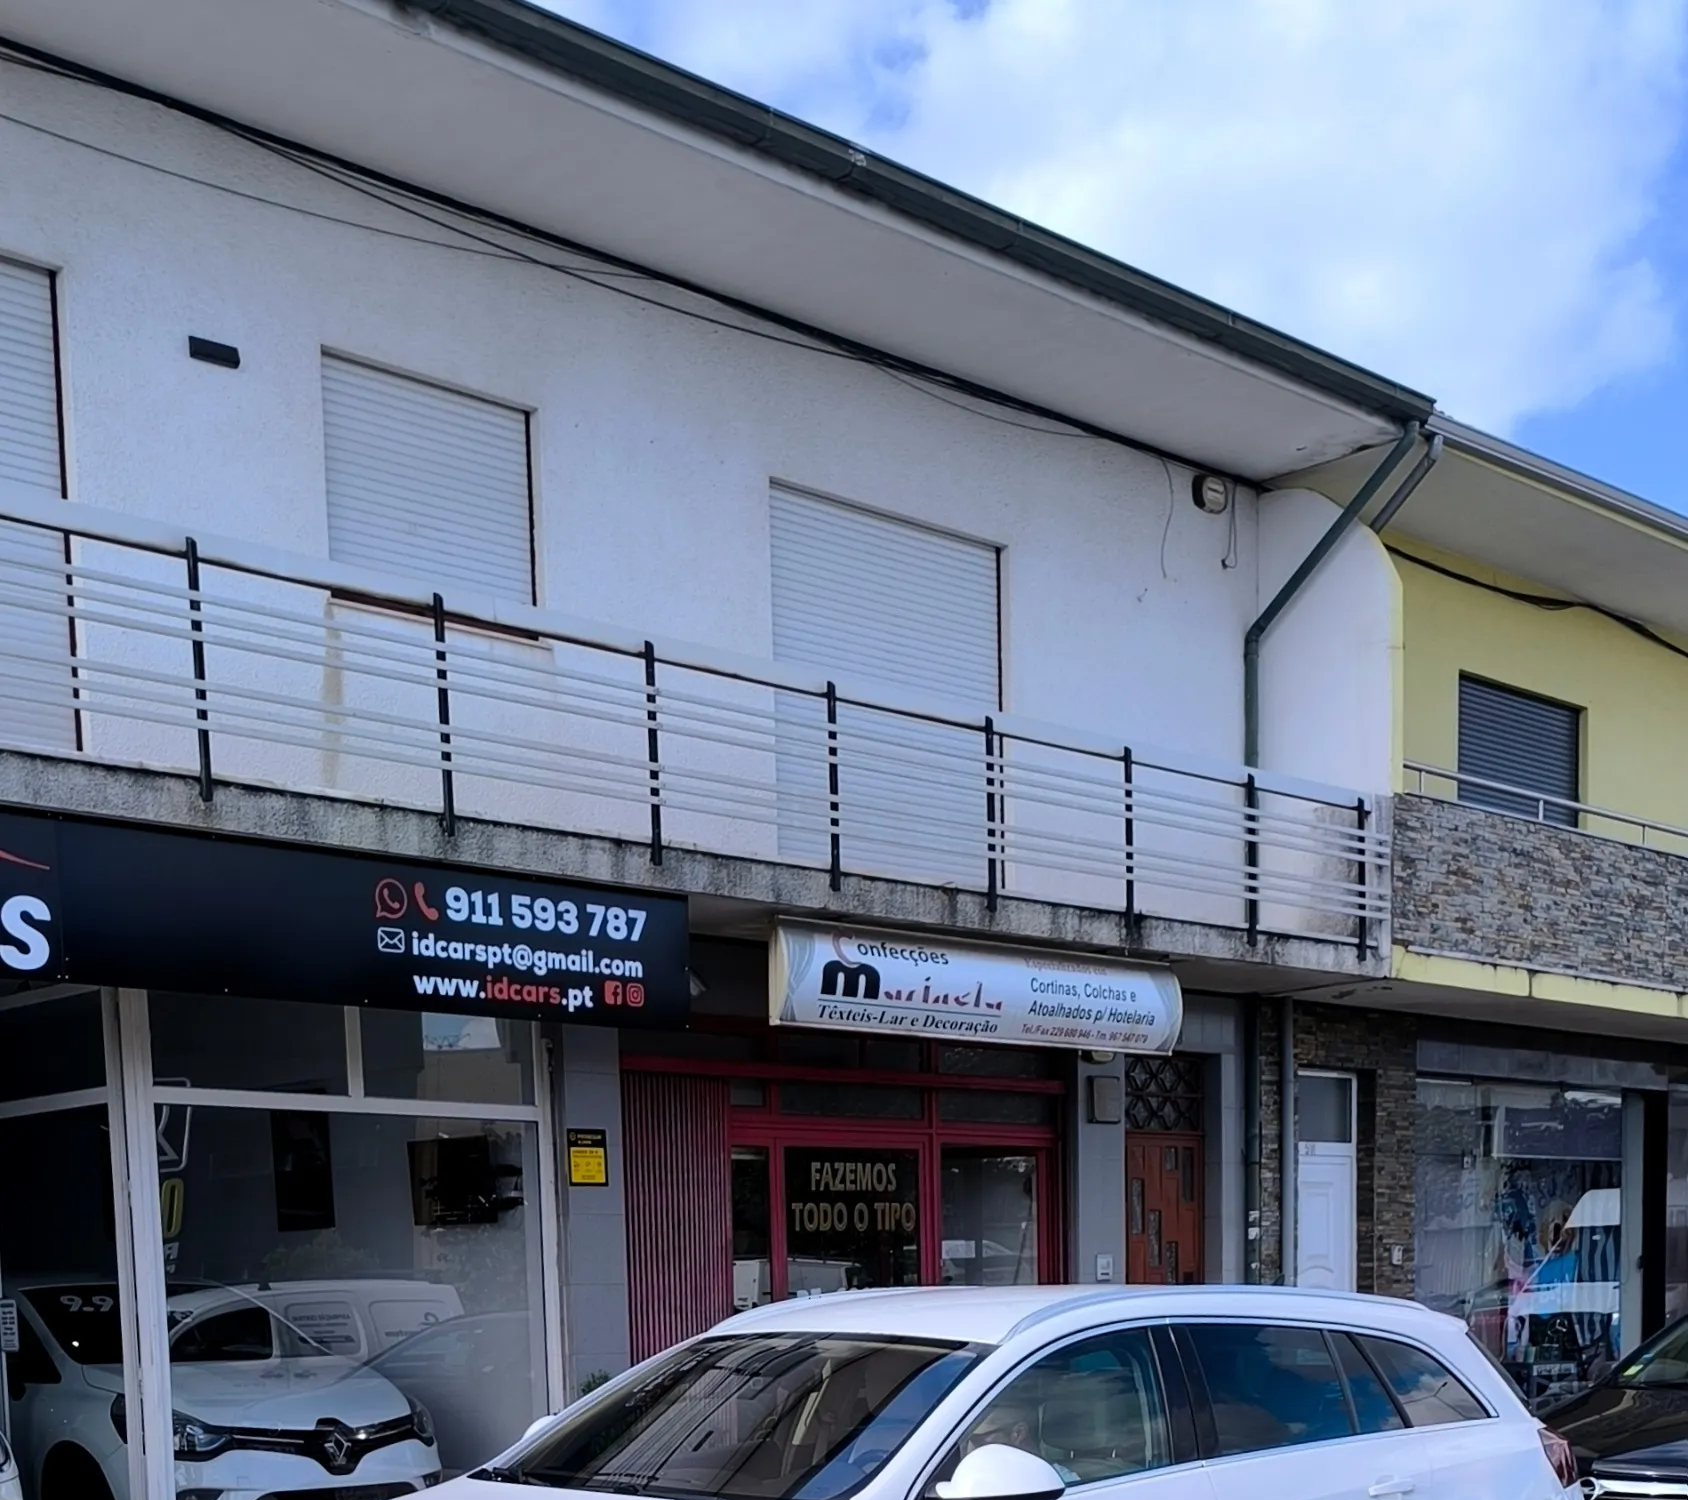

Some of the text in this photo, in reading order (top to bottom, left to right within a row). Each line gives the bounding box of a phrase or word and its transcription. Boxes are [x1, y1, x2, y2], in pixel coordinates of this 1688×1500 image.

[445, 887, 647, 942] 911 593 787
[411, 931, 644, 979] idcarspt@gmail.com
[832, 929, 949, 968] Confecções
[413, 975, 594, 1013] www.idcars.pt
[1030, 977, 1137, 1003] Cortinas, Colchas e
[817, 1004, 999, 1036] Têxteis-Lar e Decoração
[1028, 1000, 1155, 1027] Atoalhados p/ Hotelaria
[811, 1162, 897, 1192] FAZEMOS
[791, 1202, 916, 1232] TODO O TIPO
